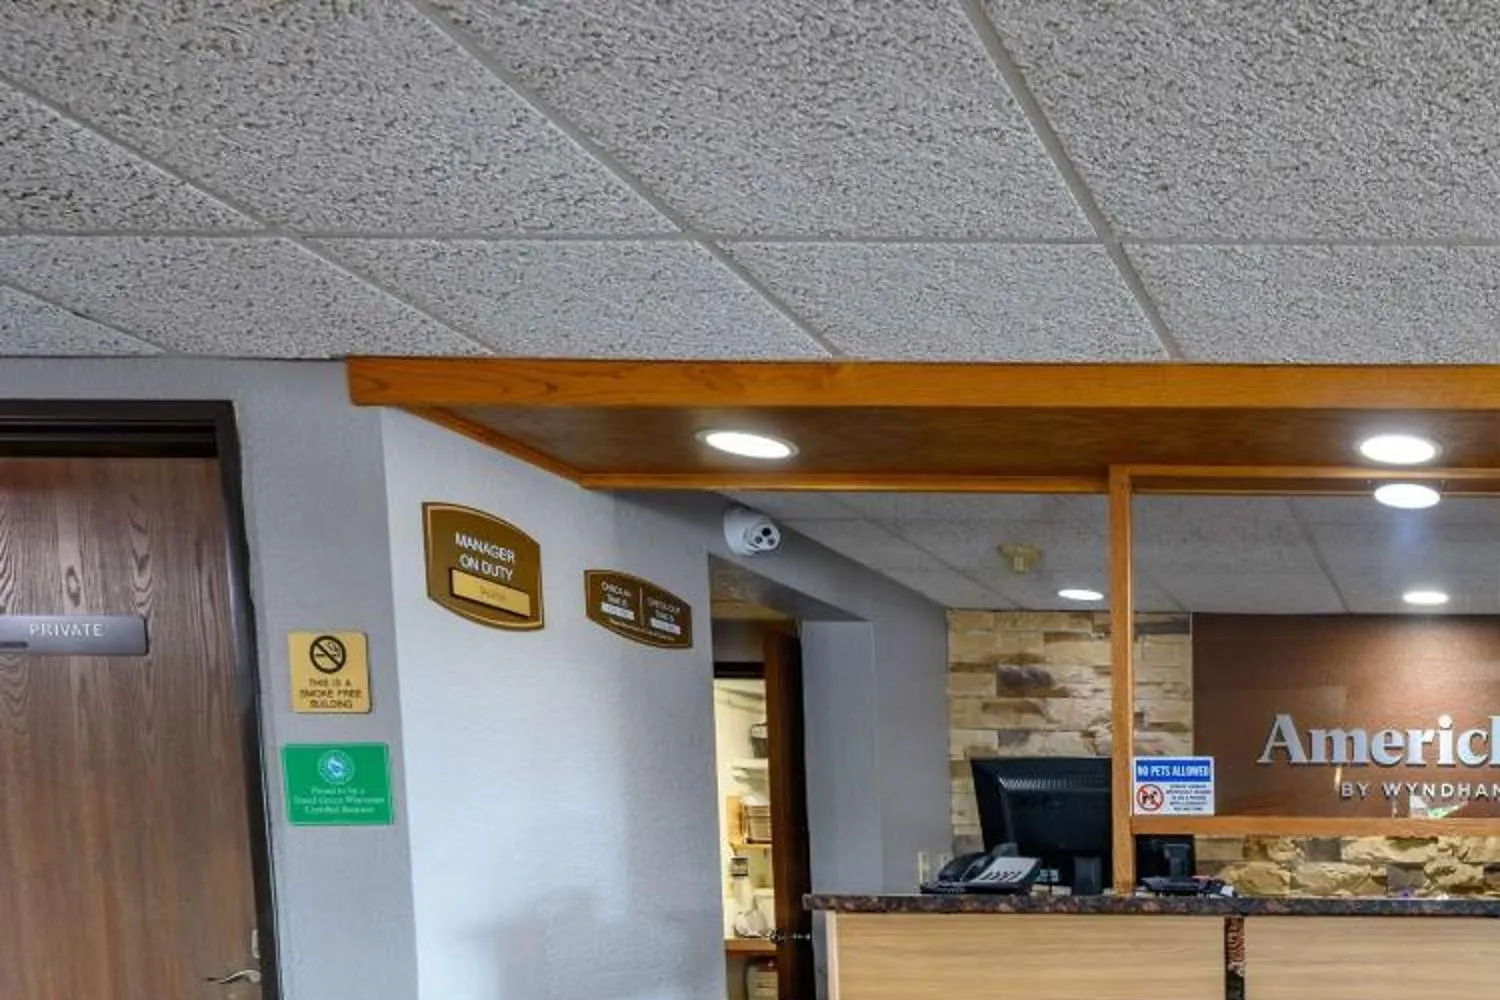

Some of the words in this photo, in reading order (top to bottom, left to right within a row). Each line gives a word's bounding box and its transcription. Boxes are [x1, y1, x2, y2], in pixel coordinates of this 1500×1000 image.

[455, 532, 515, 563] MANAGER
[460, 553, 479, 571] ON
[481, 560, 513, 580] DUTY
[29, 623, 104, 637] PRIVATE
[309, 678, 328, 687] THIS
[345, 678, 352, 687] A
[299, 688, 334, 699] SMOKE
[337, 689, 362, 699] FREE
[308, 699, 353, 710] BUILDING
[1137, 765, 1149, 777] NO
[1151, 765, 1170, 777] PETS
[1171, 765, 1209, 777] ALLOWED
[1341, 782, 1370, 798] BY
